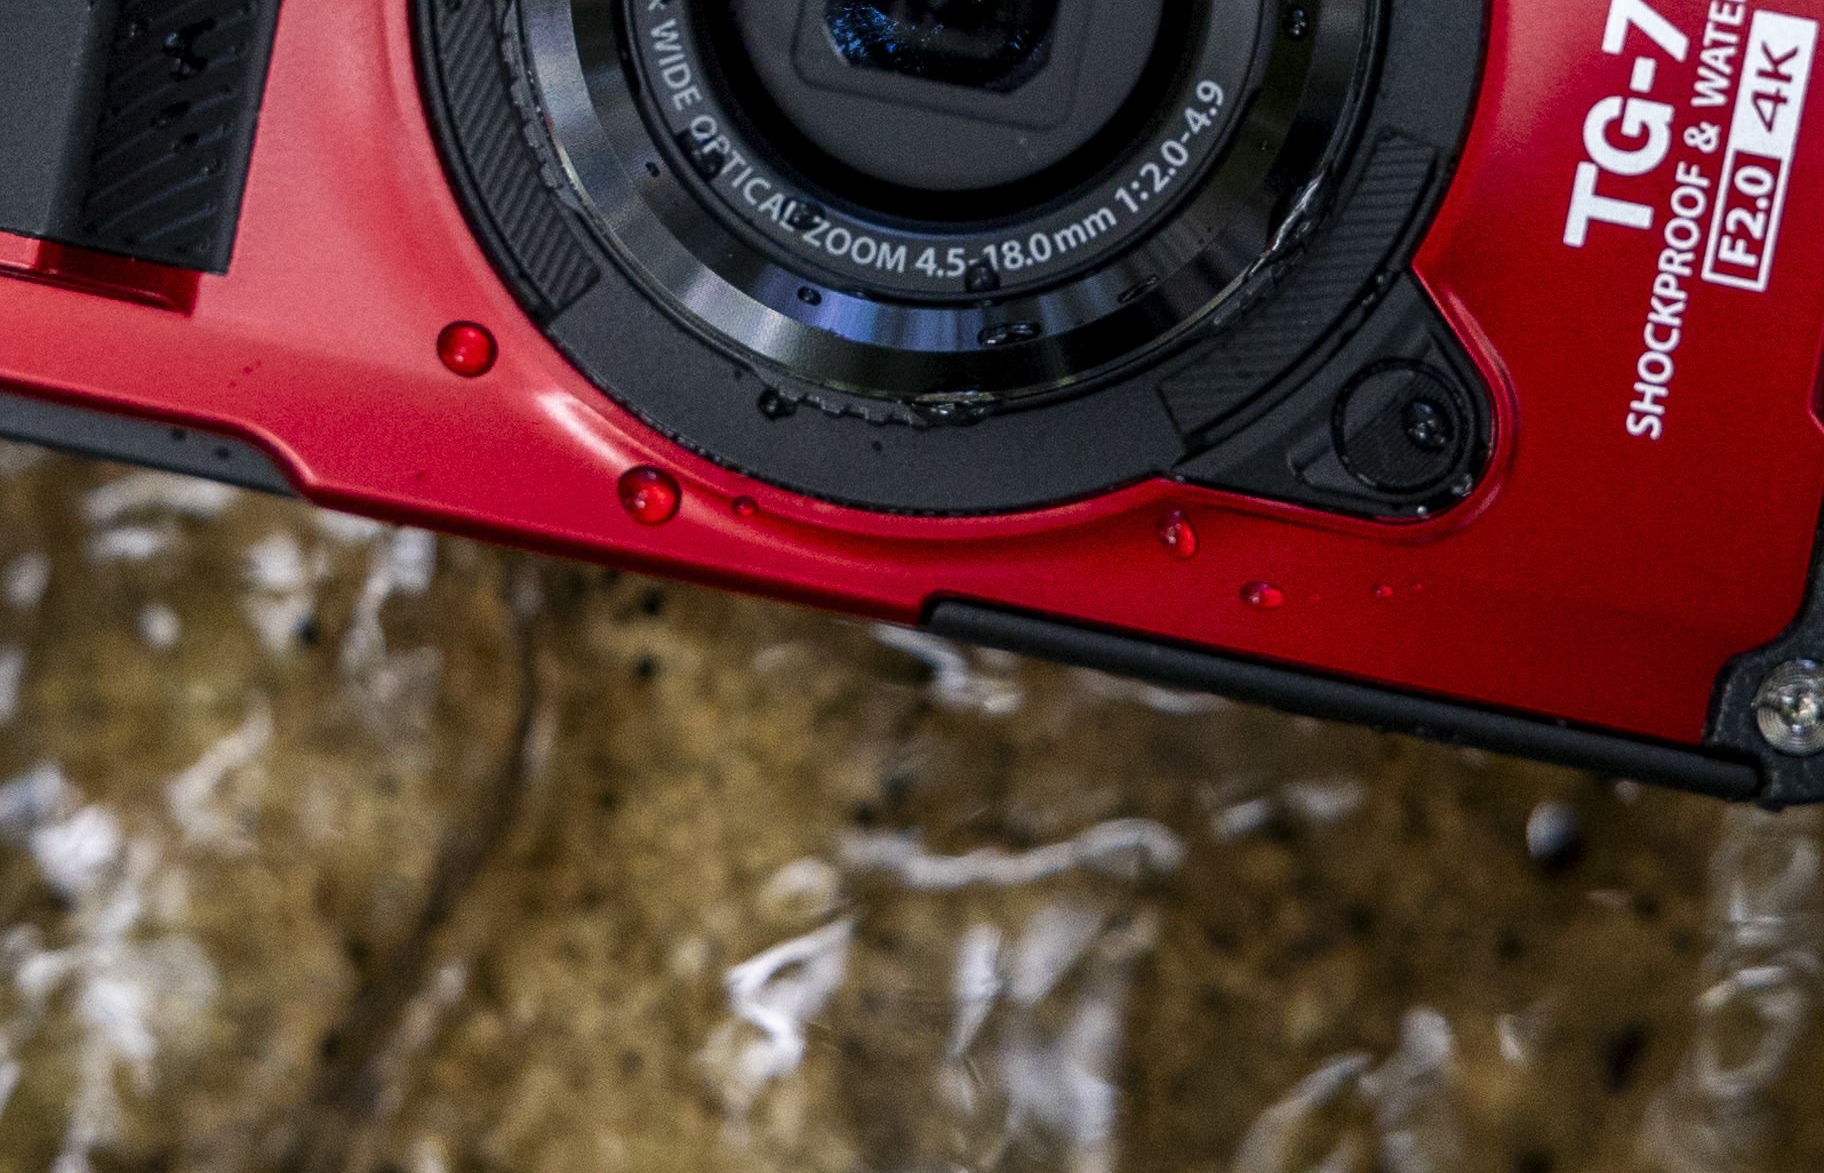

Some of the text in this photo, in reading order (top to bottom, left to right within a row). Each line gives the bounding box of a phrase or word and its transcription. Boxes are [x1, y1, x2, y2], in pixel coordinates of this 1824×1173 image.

[650, 19, 703, 112] WIDE
[690, 114, 800, 233] OPTICAL
[802, 219, 908, 273] ZOOM
[1114, 79, 1225, 214] 1:2.0-4.9
[1750, 40, 1801, 133] 4K
[1626, 162, 1712, 441] SHOCKPROOF
[1683, 124, 1722, 154] &
[1718, 165, 1776, 267] F2.0
